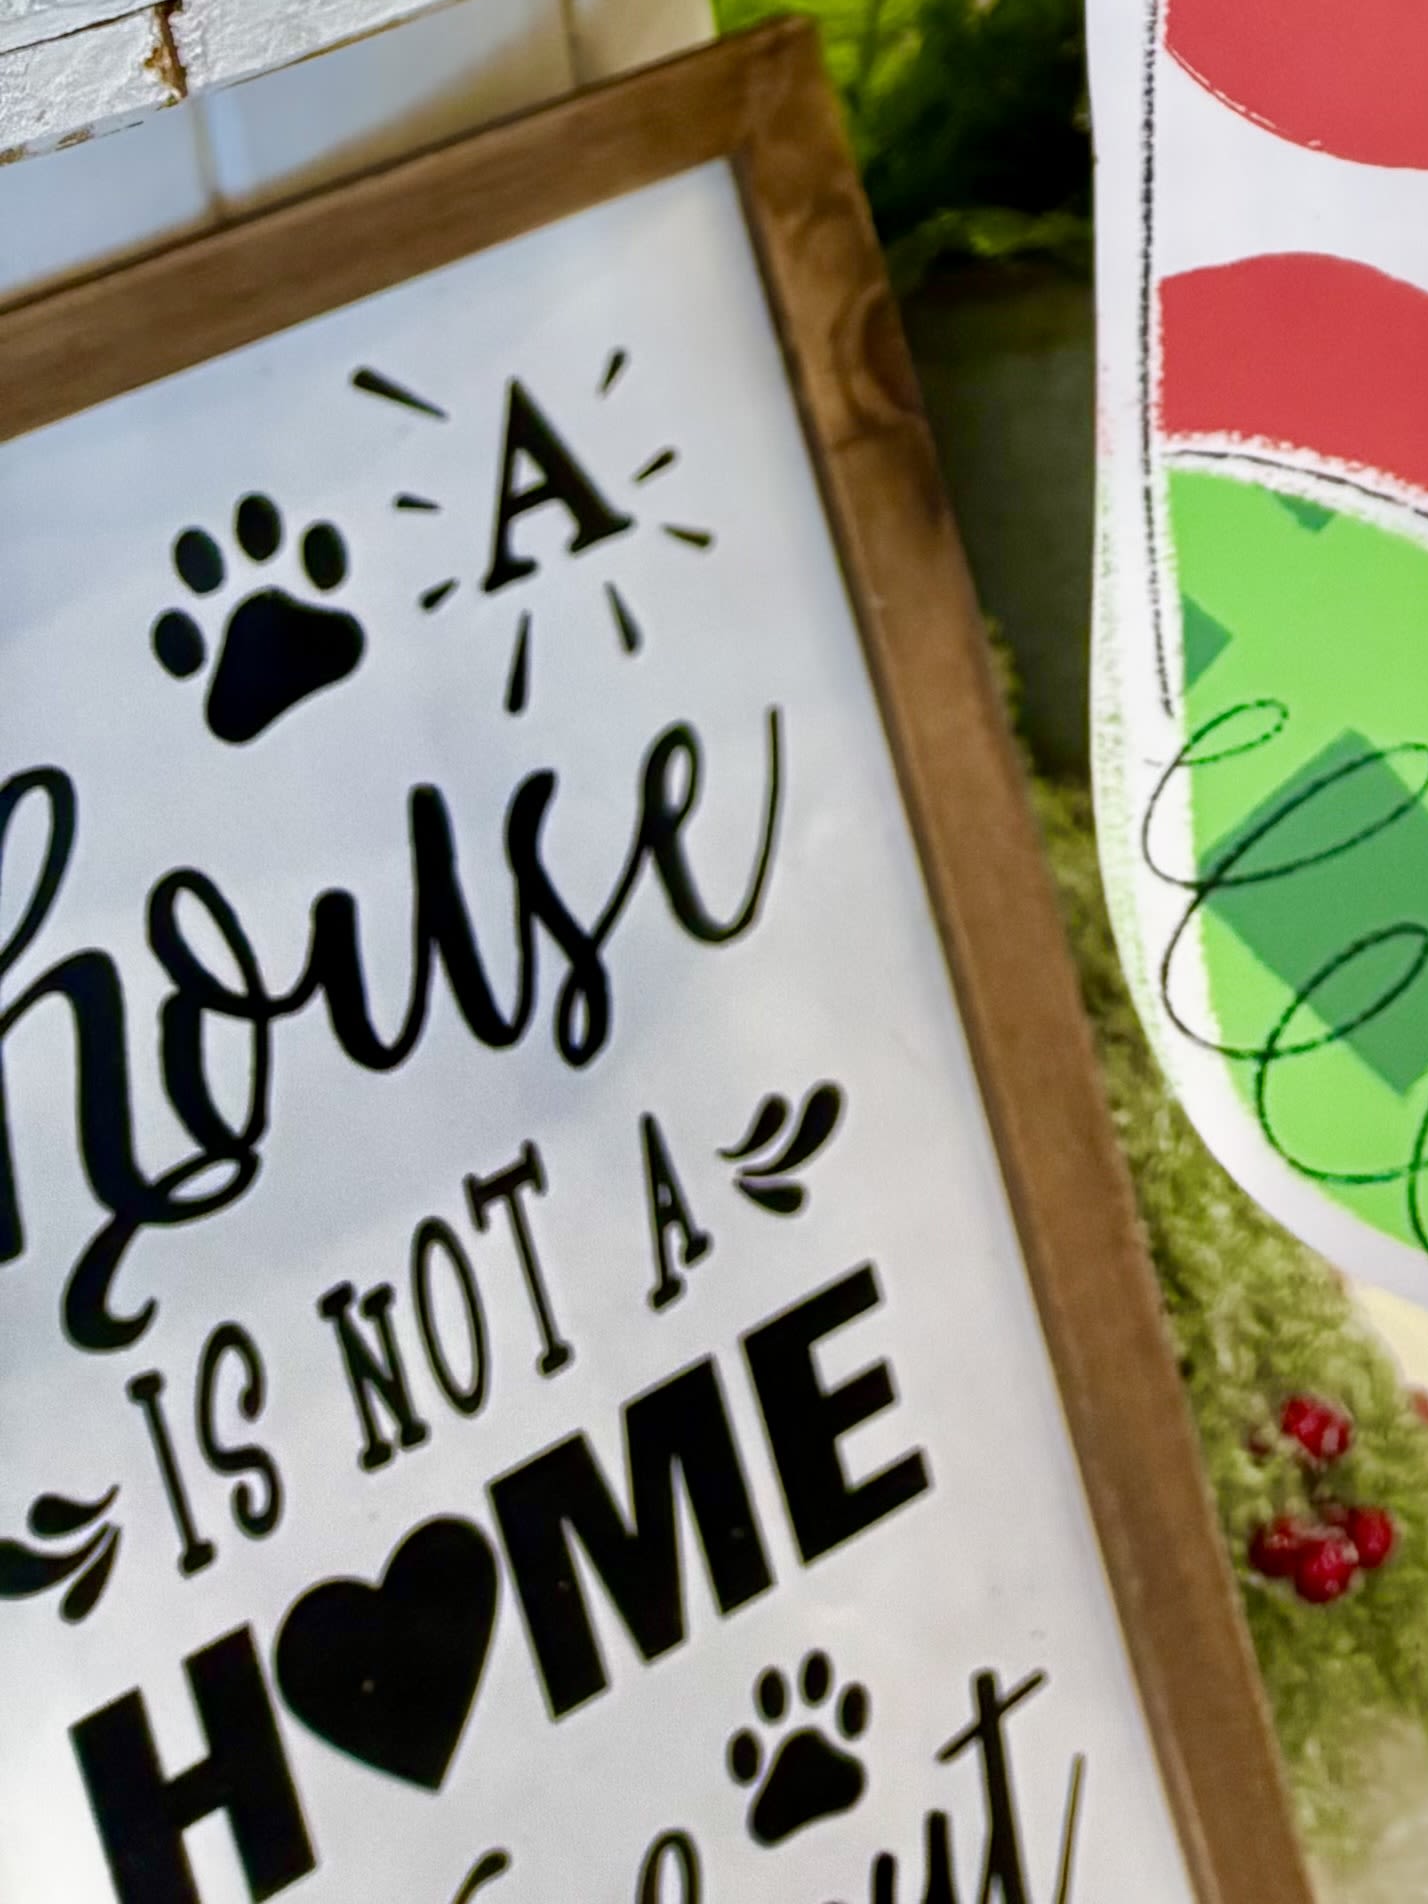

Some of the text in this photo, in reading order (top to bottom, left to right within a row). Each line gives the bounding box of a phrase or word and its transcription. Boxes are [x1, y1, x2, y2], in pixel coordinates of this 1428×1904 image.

[482, 377, 637, 594] A
[0, 705, 785, 1352] house
[126, 1111, 713, 1578] IS NOT A
